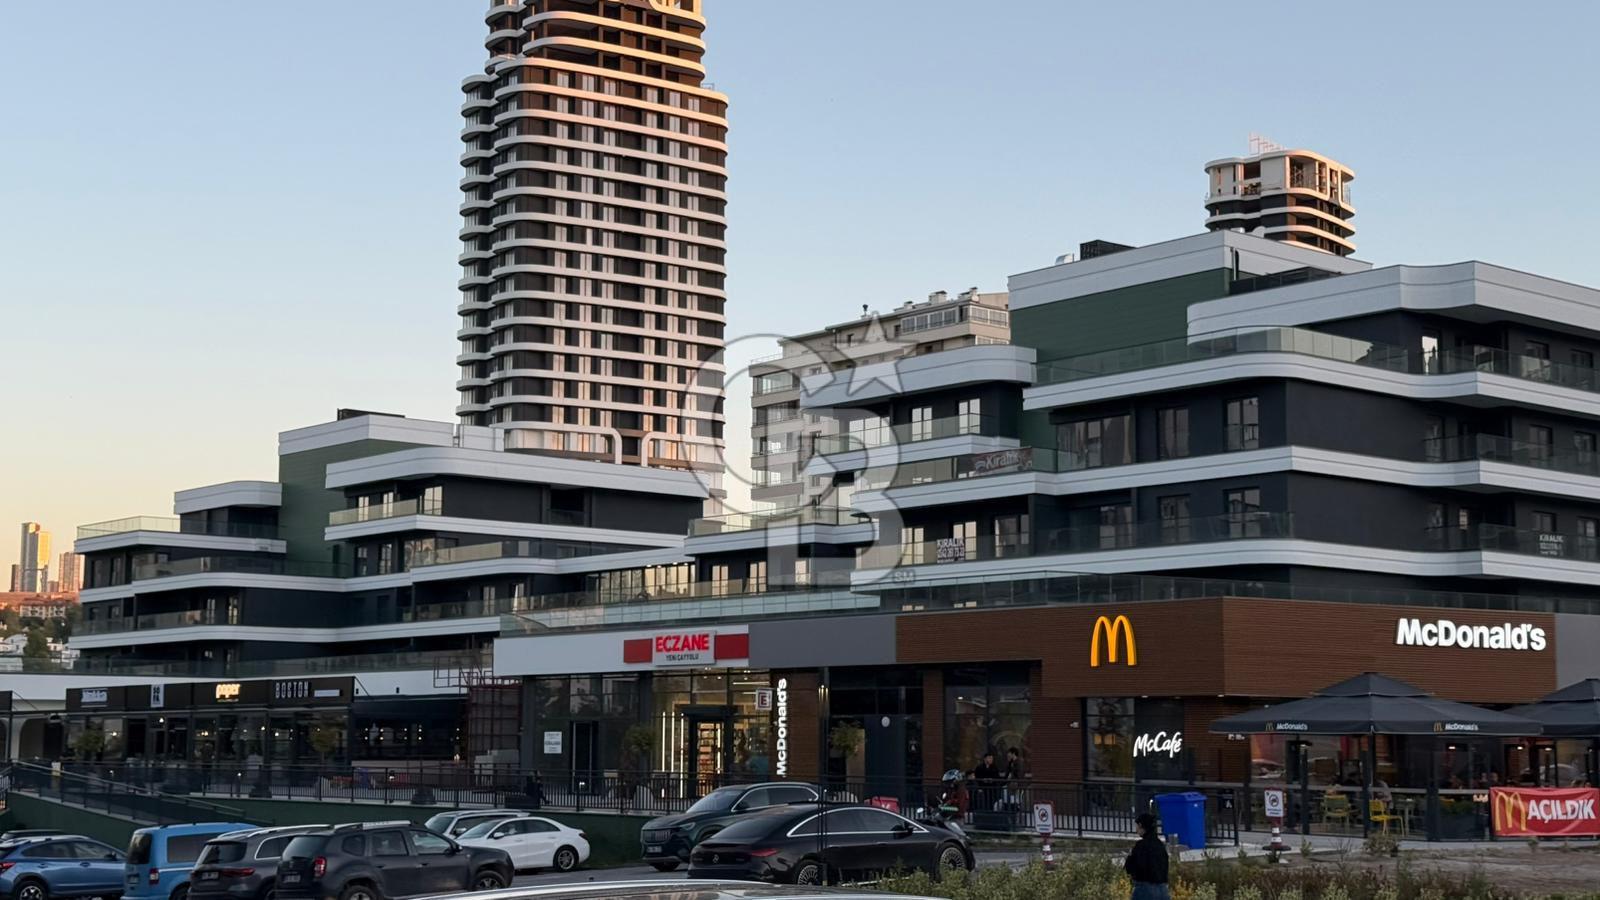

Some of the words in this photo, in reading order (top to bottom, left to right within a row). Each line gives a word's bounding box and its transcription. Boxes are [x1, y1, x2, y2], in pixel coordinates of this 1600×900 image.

[656, 634, 710, 652] ECZANE
[1397, 618, 1547, 651] McDonald's
[275, 681, 309, 699] BOSTON
[776, 678, 787, 777] McDonald's
[1276, 723, 1308, 731] McDonald's
[1133, 731, 1182, 758] McCafé
[1527, 799, 1596, 824] AÇILDIK
